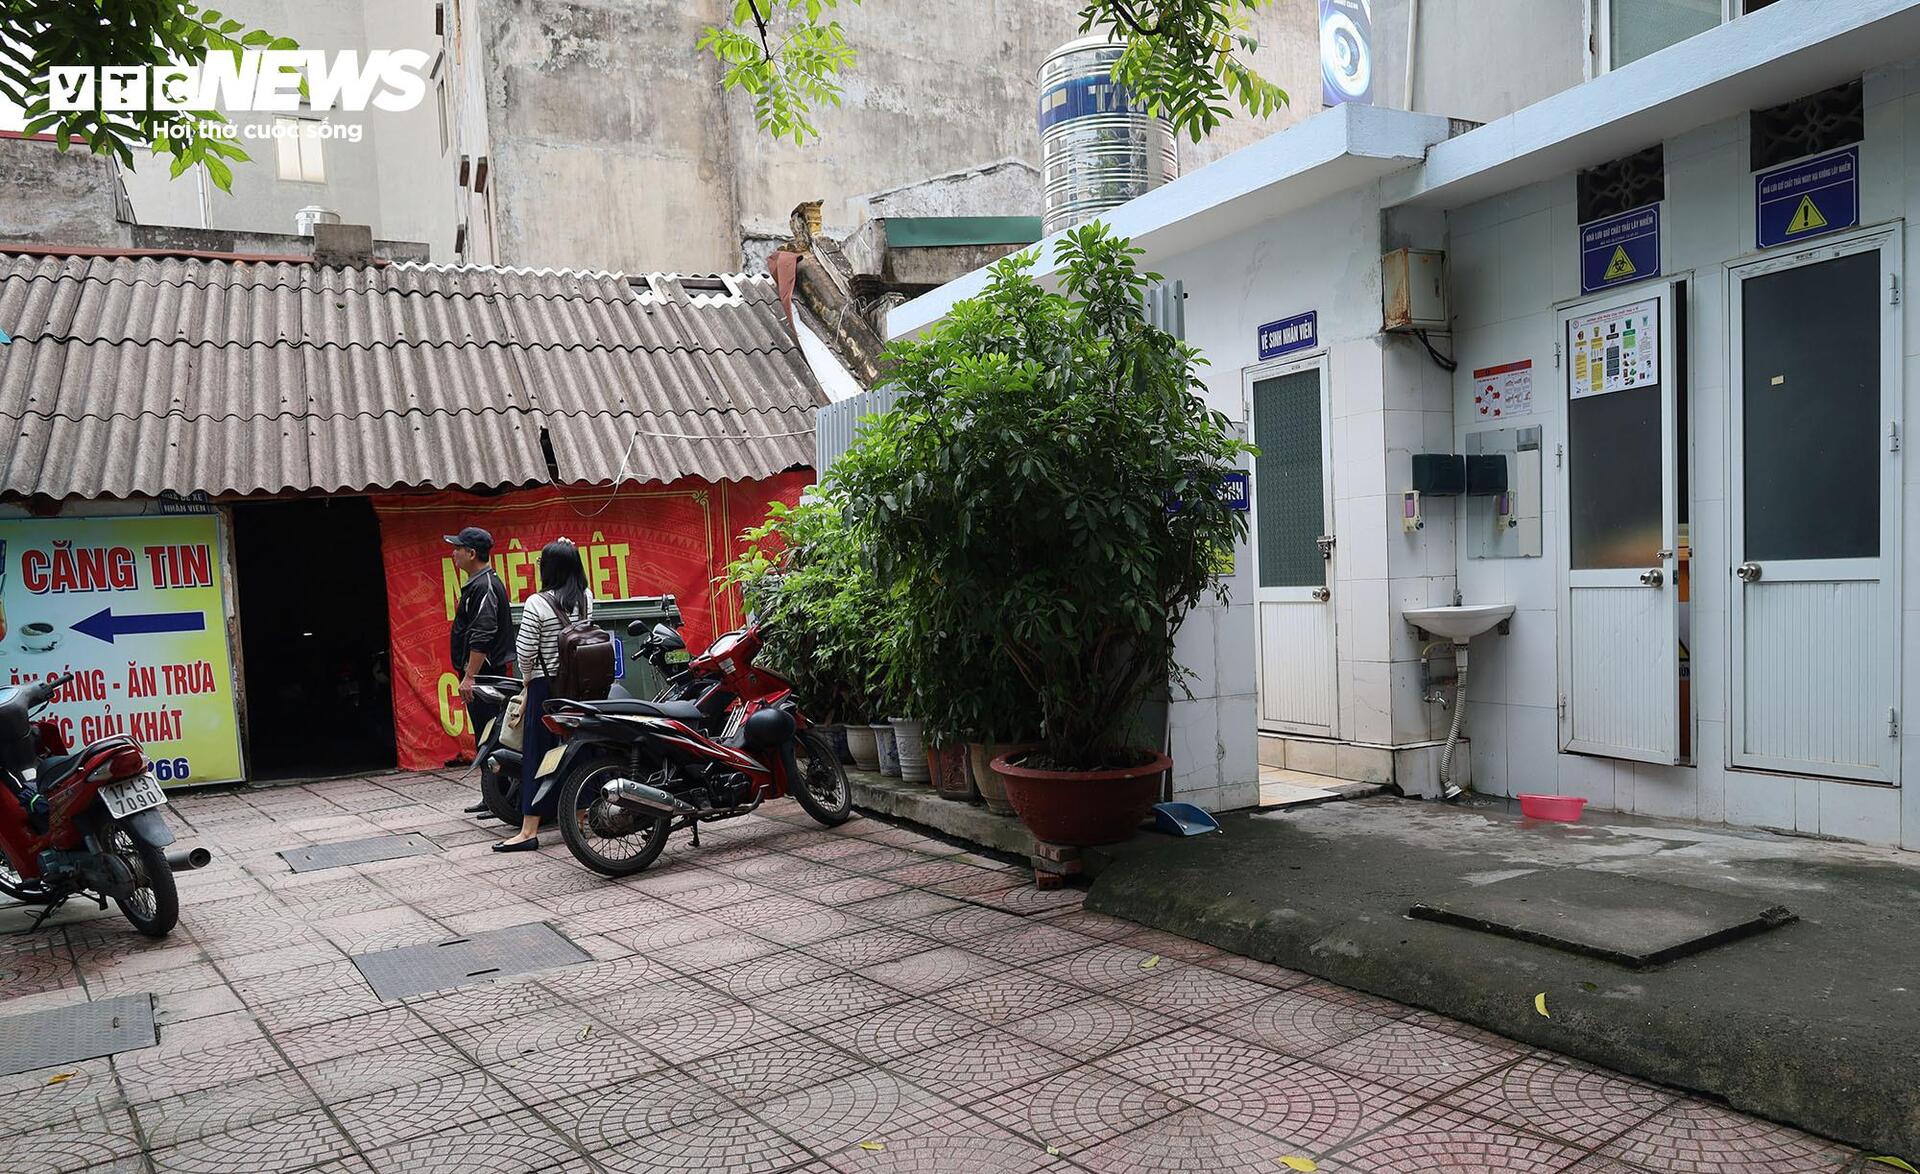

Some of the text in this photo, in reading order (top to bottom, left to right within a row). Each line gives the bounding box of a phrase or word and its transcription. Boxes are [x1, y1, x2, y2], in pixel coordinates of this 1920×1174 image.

[21, 539, 213, 594] CĂNG TIN
[128, 660, 158, 699] ĂN
[161, 660, 216, 696] TRƯA
[129, 704, 183, 744] KHÁT
[147, 757, 190, 781] 66
[109, 777, 150, 800] 17-L3
[116, 791, 158, 815] 7090
